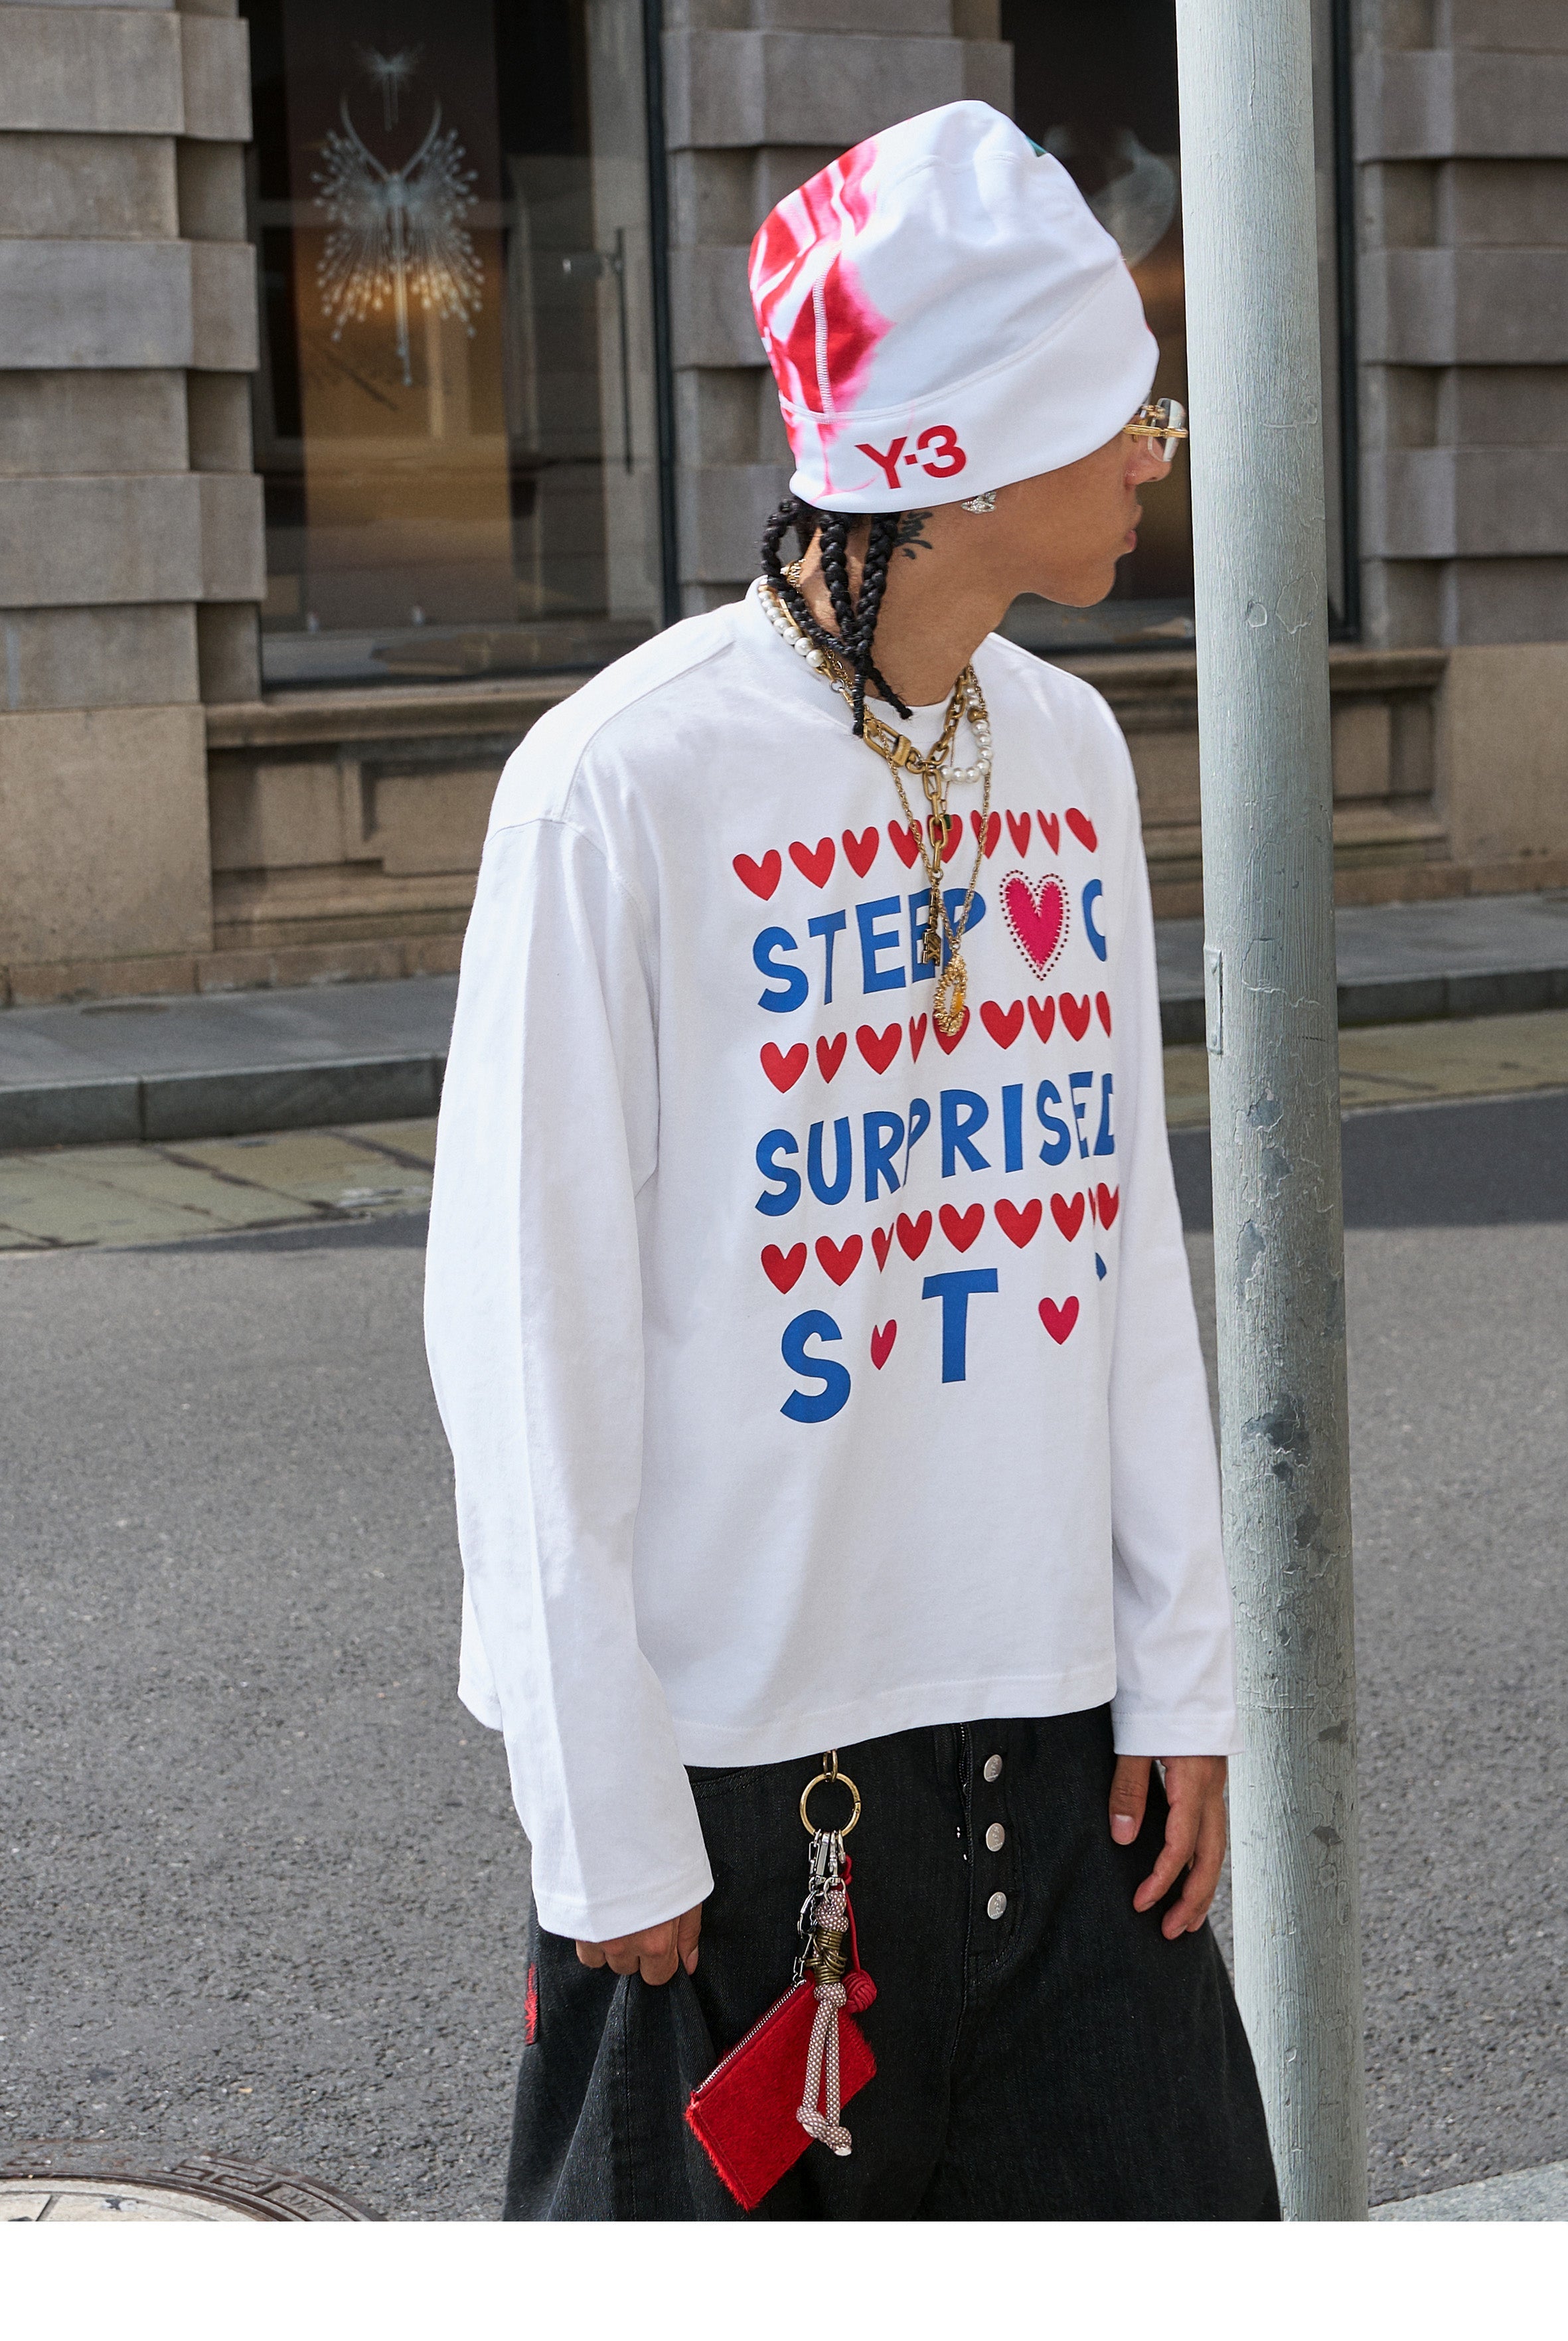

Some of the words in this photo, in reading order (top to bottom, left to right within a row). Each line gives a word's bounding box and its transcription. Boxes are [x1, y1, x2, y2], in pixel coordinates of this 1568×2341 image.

[856, 425, 967, 489] Y-3
[753, 888, 986, 1013] STEEP
[781, 1309, 851, 1423] S
[921, 1267, 998, 1383] T
